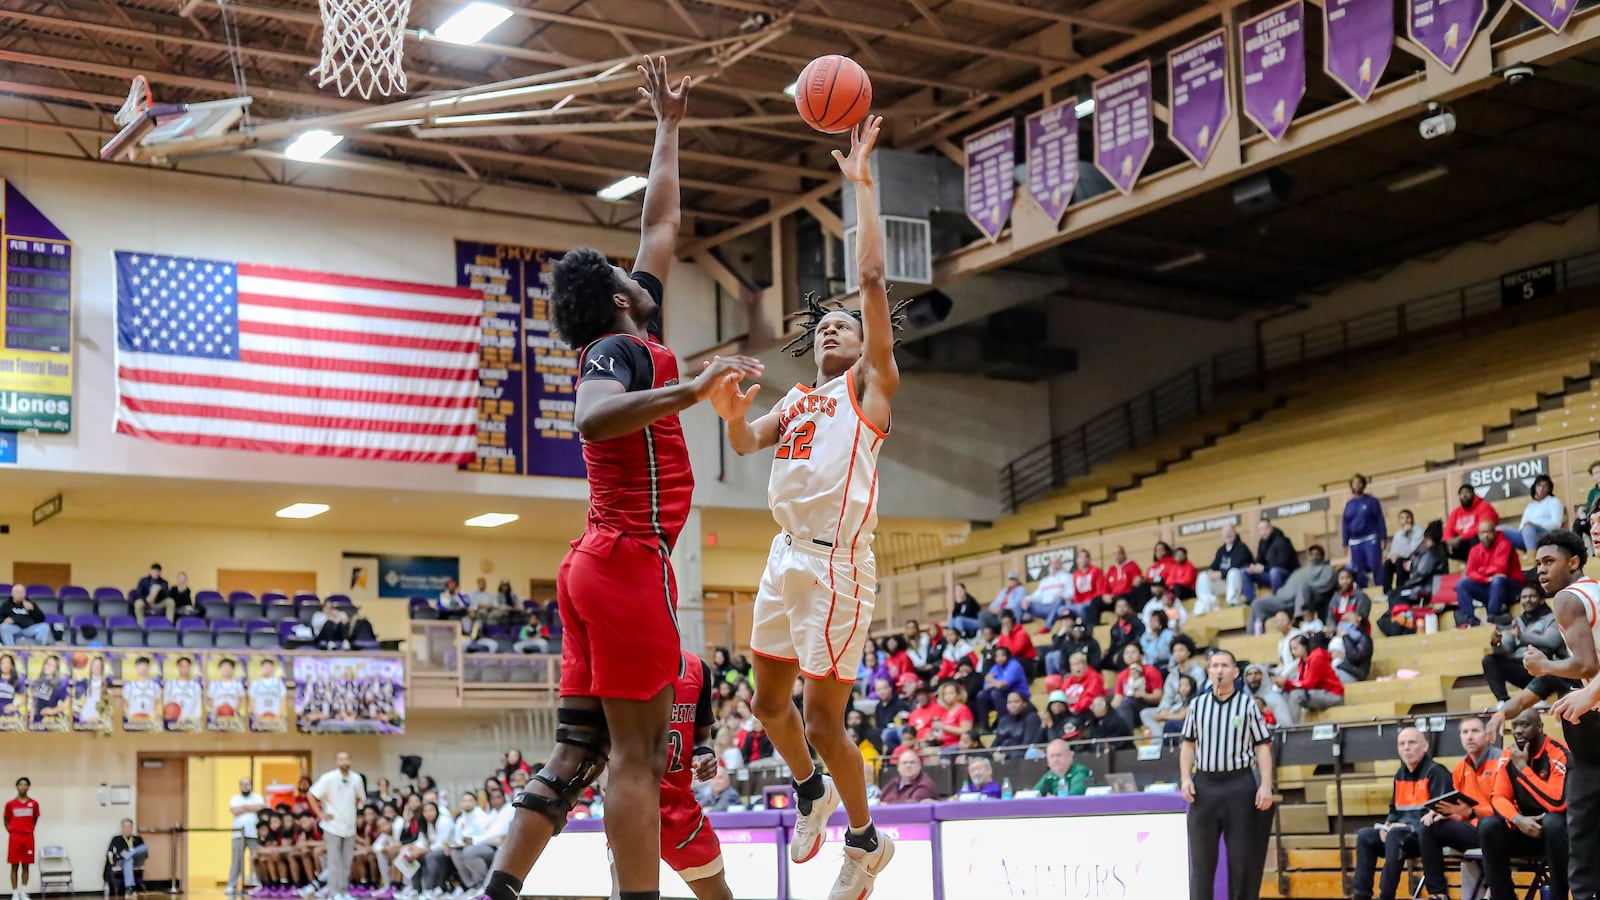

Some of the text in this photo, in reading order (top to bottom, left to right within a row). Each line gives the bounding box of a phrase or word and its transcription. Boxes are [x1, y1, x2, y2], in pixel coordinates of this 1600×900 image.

[1256, 11, 1286, 34] STATE
[1245, 19, 1300, 53] QUALIFIERS
[1172, 36, 1223, 67] BASKETBALL
[1261, 47, 1286, 68] GOLF
[1098, 71, 1148, 100] WRESTLING
[1523, 282, 1535, 299] 5
[585, 354, 615, 375] XI
[8, 392, 70, 416] Jones
[1470, 459, 1542, 487] SECTION
[1502, 482, 1511, 498] 1
